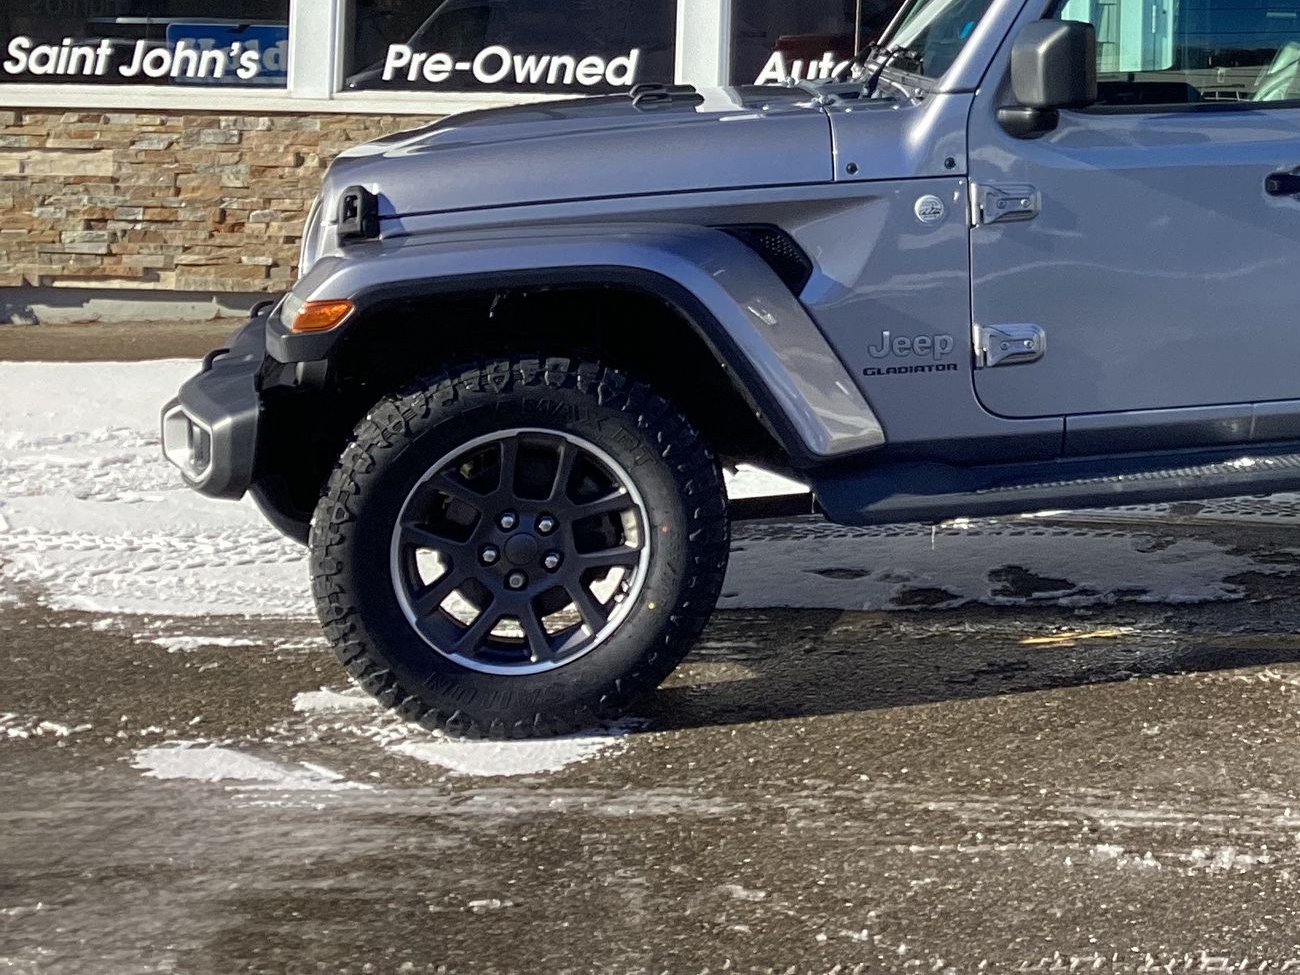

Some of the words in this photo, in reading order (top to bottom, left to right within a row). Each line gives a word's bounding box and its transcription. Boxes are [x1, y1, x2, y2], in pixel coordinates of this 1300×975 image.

[3, 36, 115, 76] Saint
[119, 39, 260, 79] John's
[382, 43, 640, 87] Pre-Owned
[867, 330, 955, 361] Jeep
[862, 363, 959, 377] GLADIATOR
